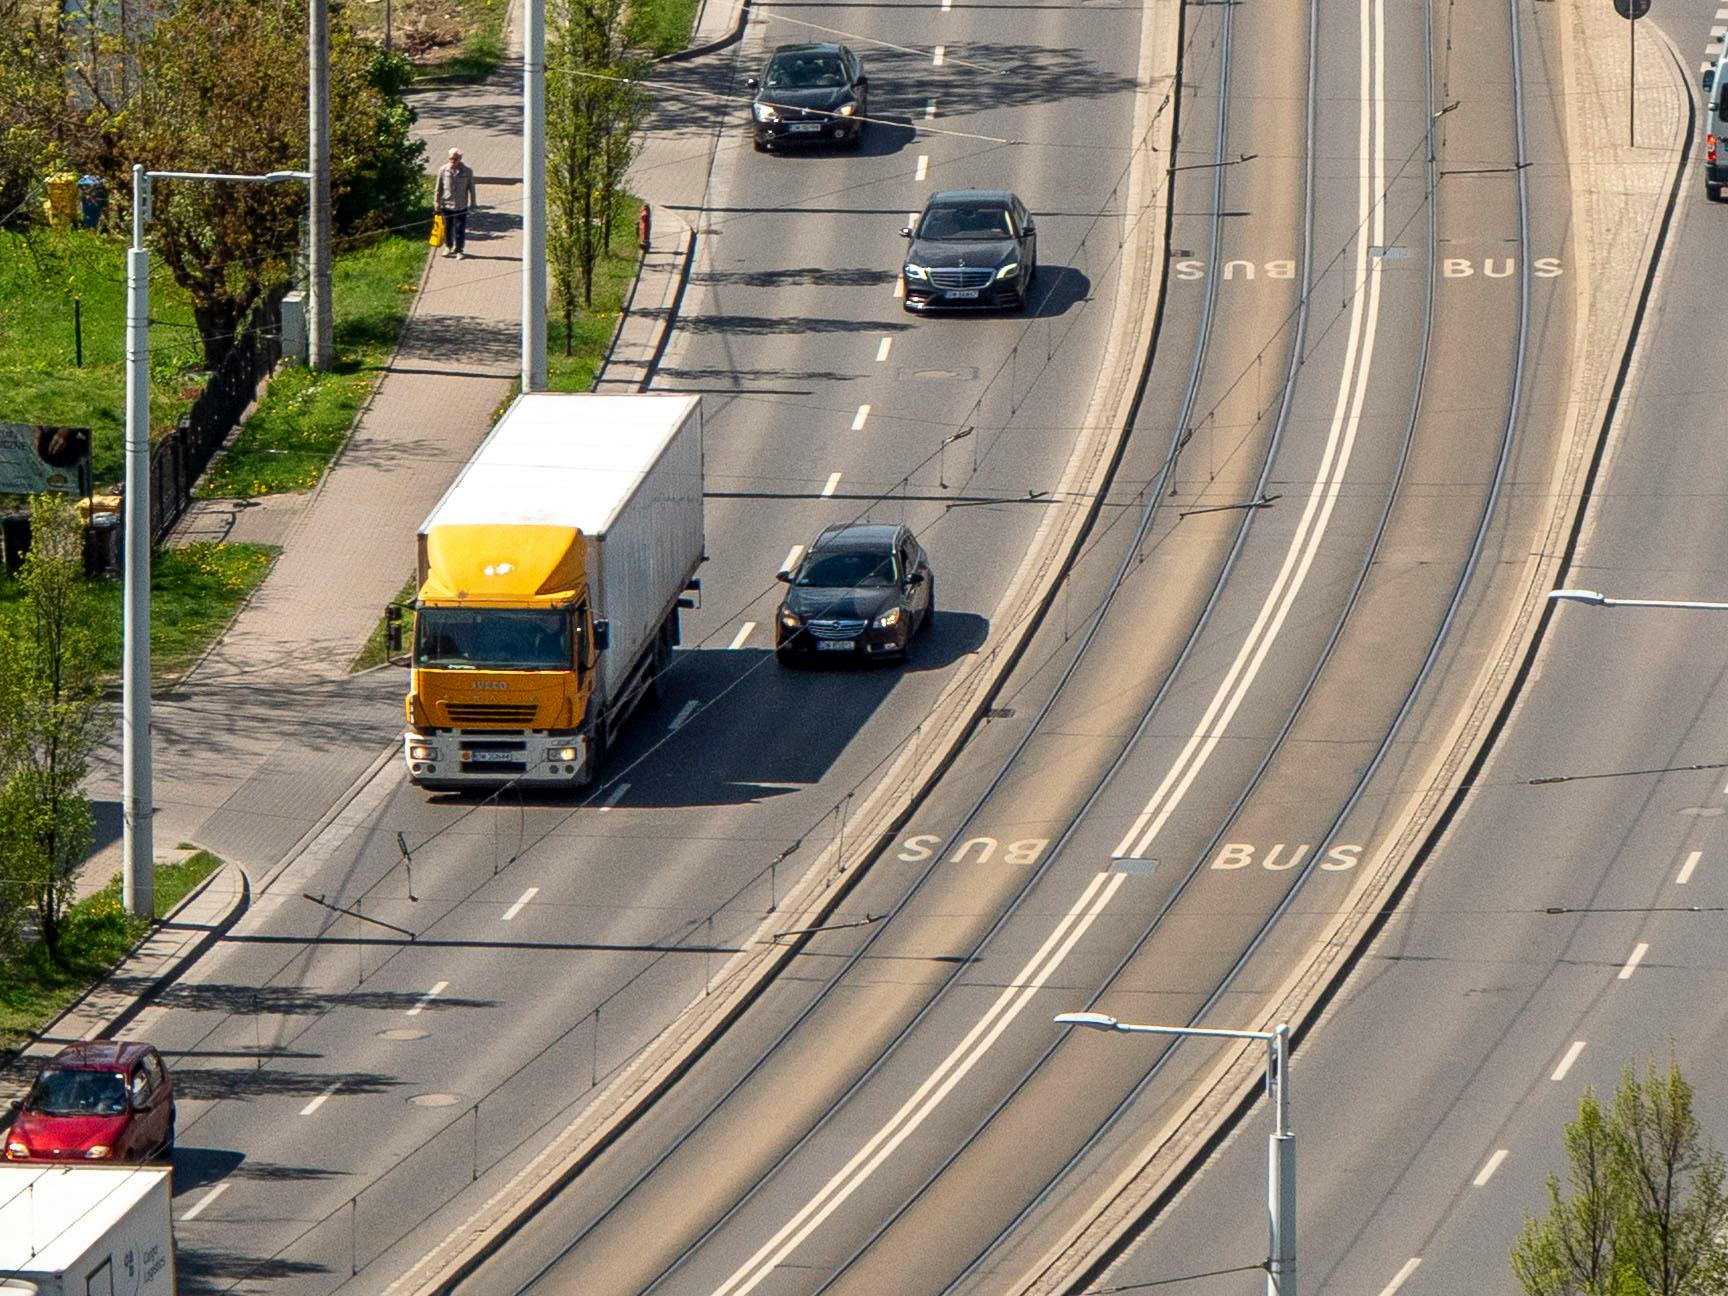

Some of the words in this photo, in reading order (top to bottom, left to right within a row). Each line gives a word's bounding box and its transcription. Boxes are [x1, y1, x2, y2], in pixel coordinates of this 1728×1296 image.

[1175, 258, 1296, 281] BUS
[1443, 256, 1565, 280] BUS
[897, 834, 1050, 866] BUS
[1211, 843, 1363, 873] BUS
